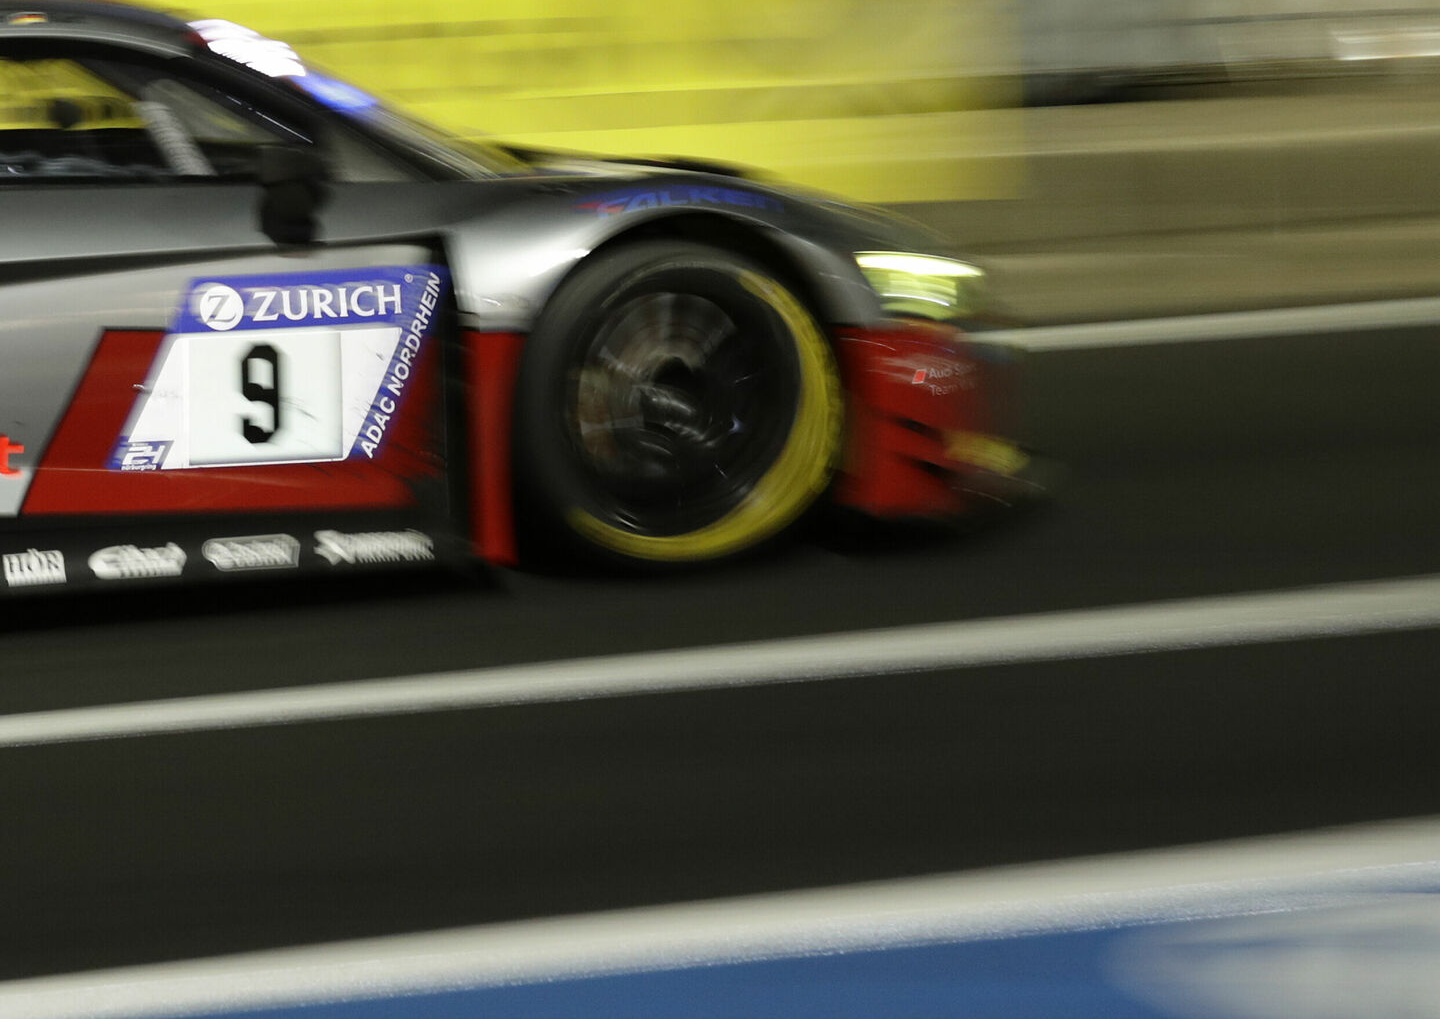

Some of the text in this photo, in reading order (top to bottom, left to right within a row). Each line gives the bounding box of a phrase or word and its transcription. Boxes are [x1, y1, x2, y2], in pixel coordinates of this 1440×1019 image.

[597, 184, 784, 219] FALKEN
[252, 284, 402, 322] ZURICH
[361, 272, 440, 458] ADAC NORDRHEIN
[242, 345, 279, 444] 9
[122, 445, 166, 465] 24
